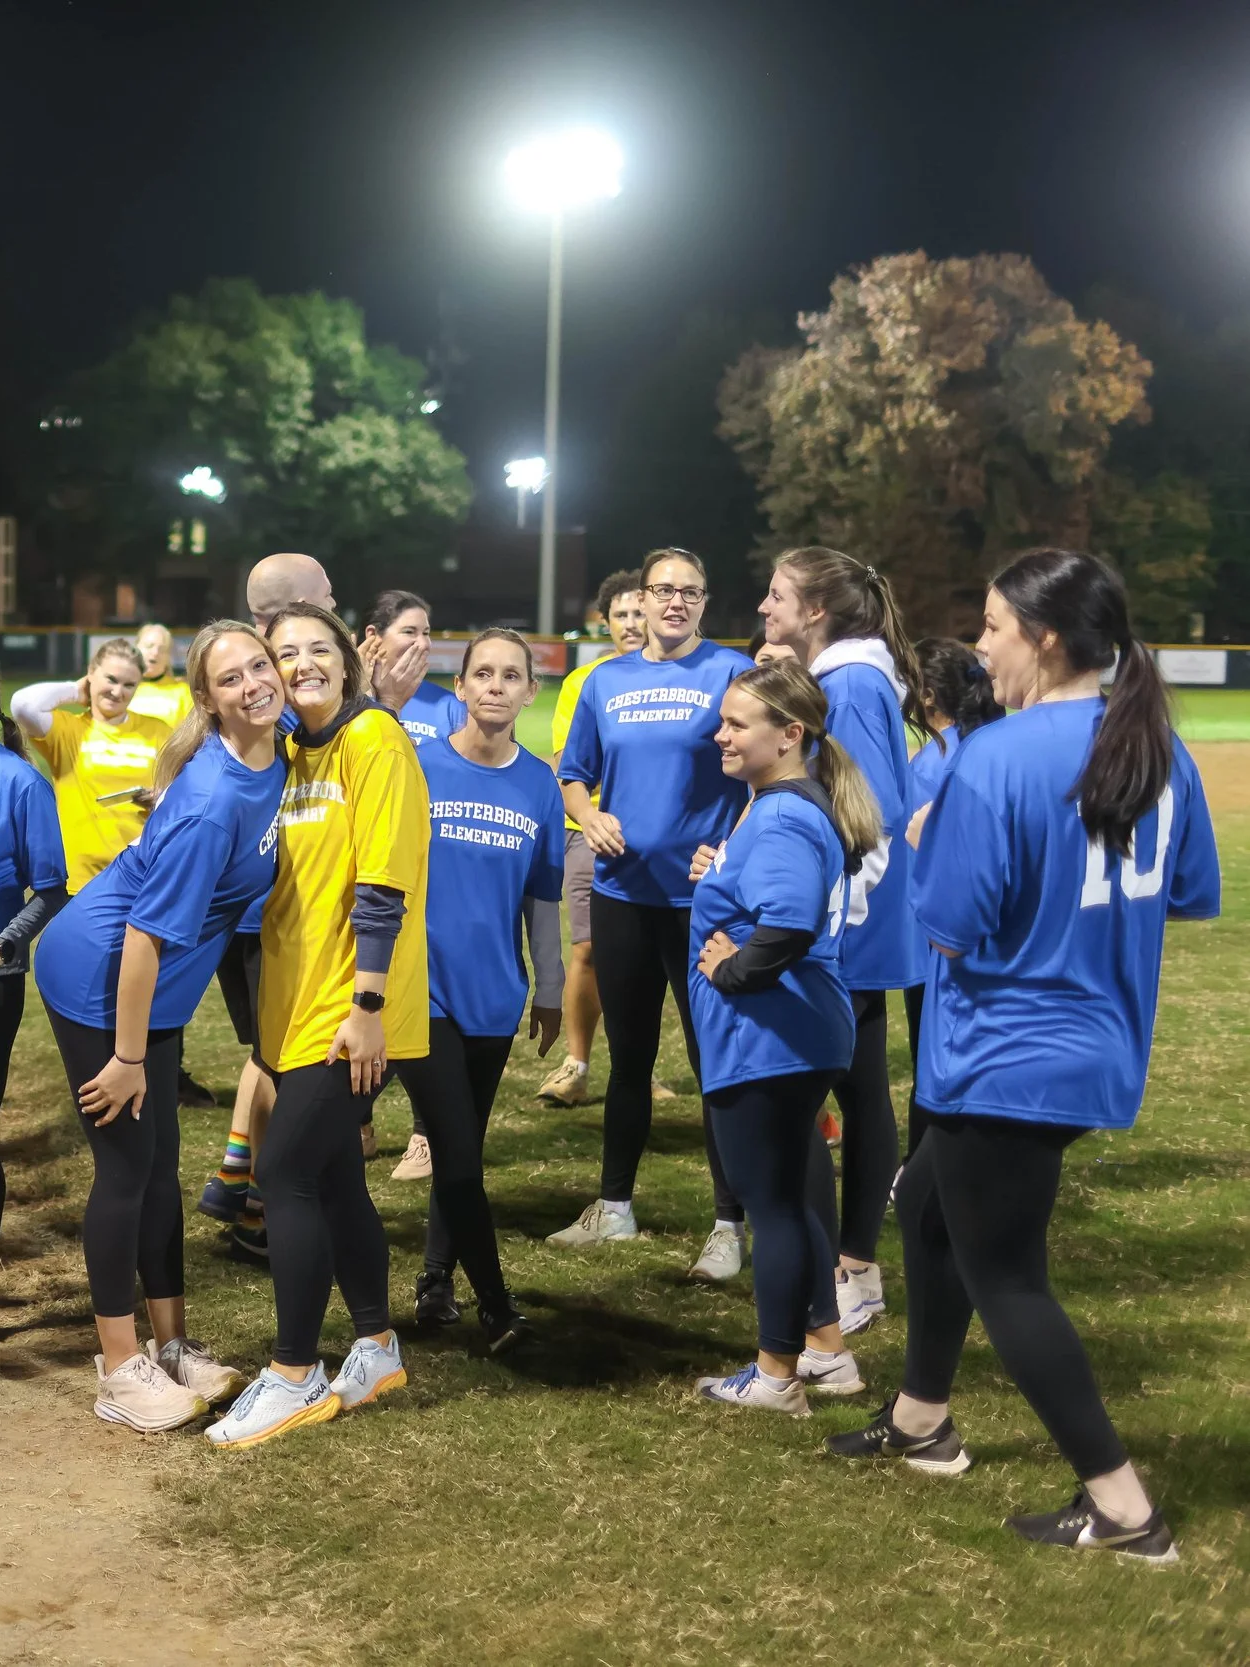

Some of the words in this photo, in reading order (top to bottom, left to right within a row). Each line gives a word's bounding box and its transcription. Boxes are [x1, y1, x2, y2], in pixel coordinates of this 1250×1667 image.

[605, 688, 713, 713] CHESTERBROOK
[617, 708, 693, 723] ELEMENTARY
[440, 823, 524, 851] ELEMENTARY
[304, 1382, 327, 1406] HOKA
